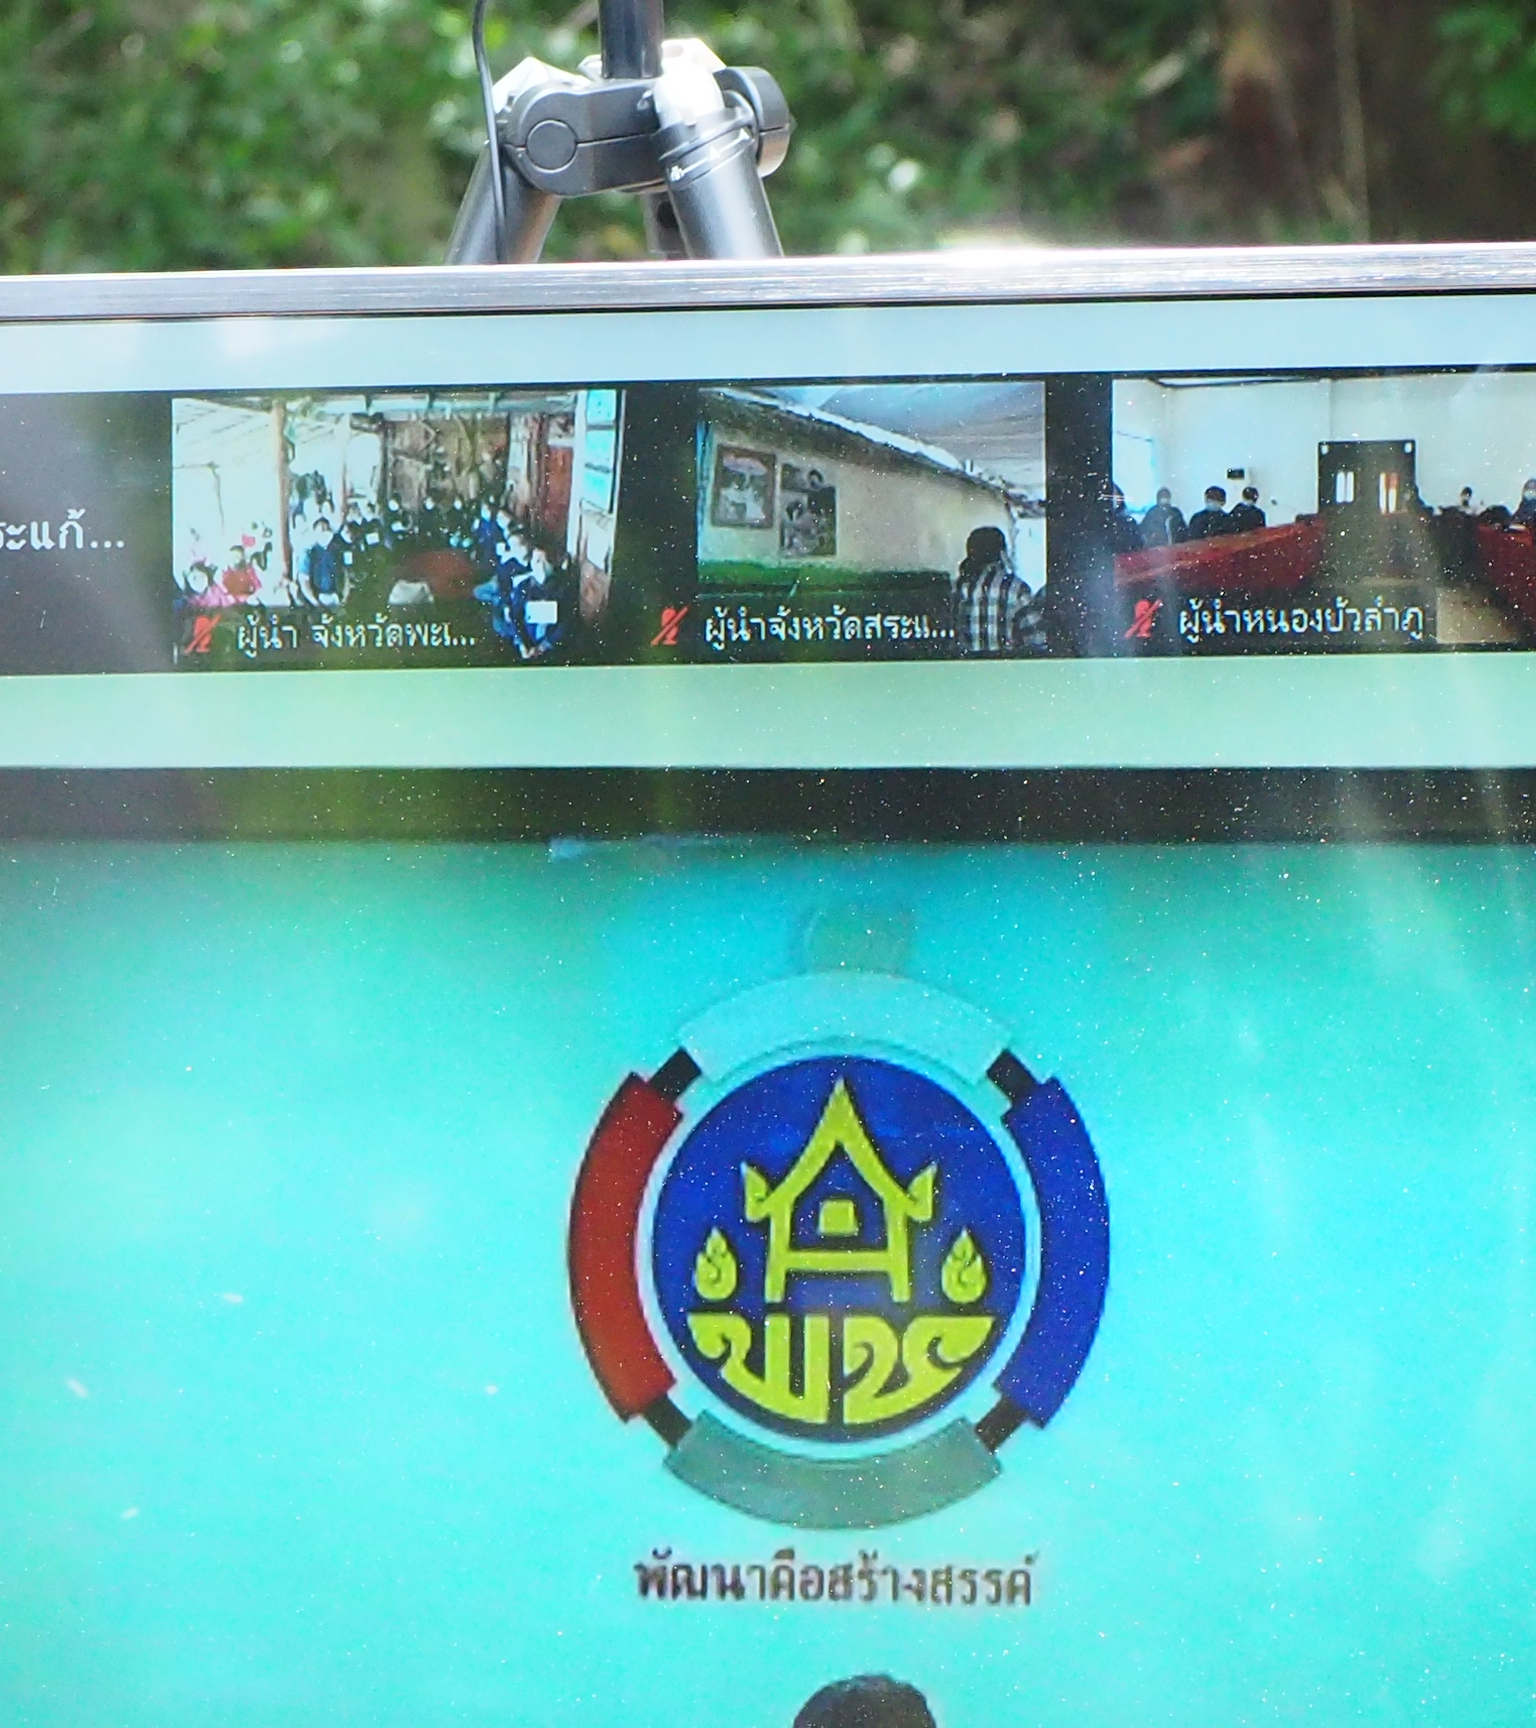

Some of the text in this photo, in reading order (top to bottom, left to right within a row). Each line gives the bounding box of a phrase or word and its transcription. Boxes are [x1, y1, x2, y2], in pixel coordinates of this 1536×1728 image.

[1178, 595, 1425, 644] ผู้นำหนองบัวลำภู
[632, 1546, 1040, 1607] พัฒนาคือสร้างสรรค์
